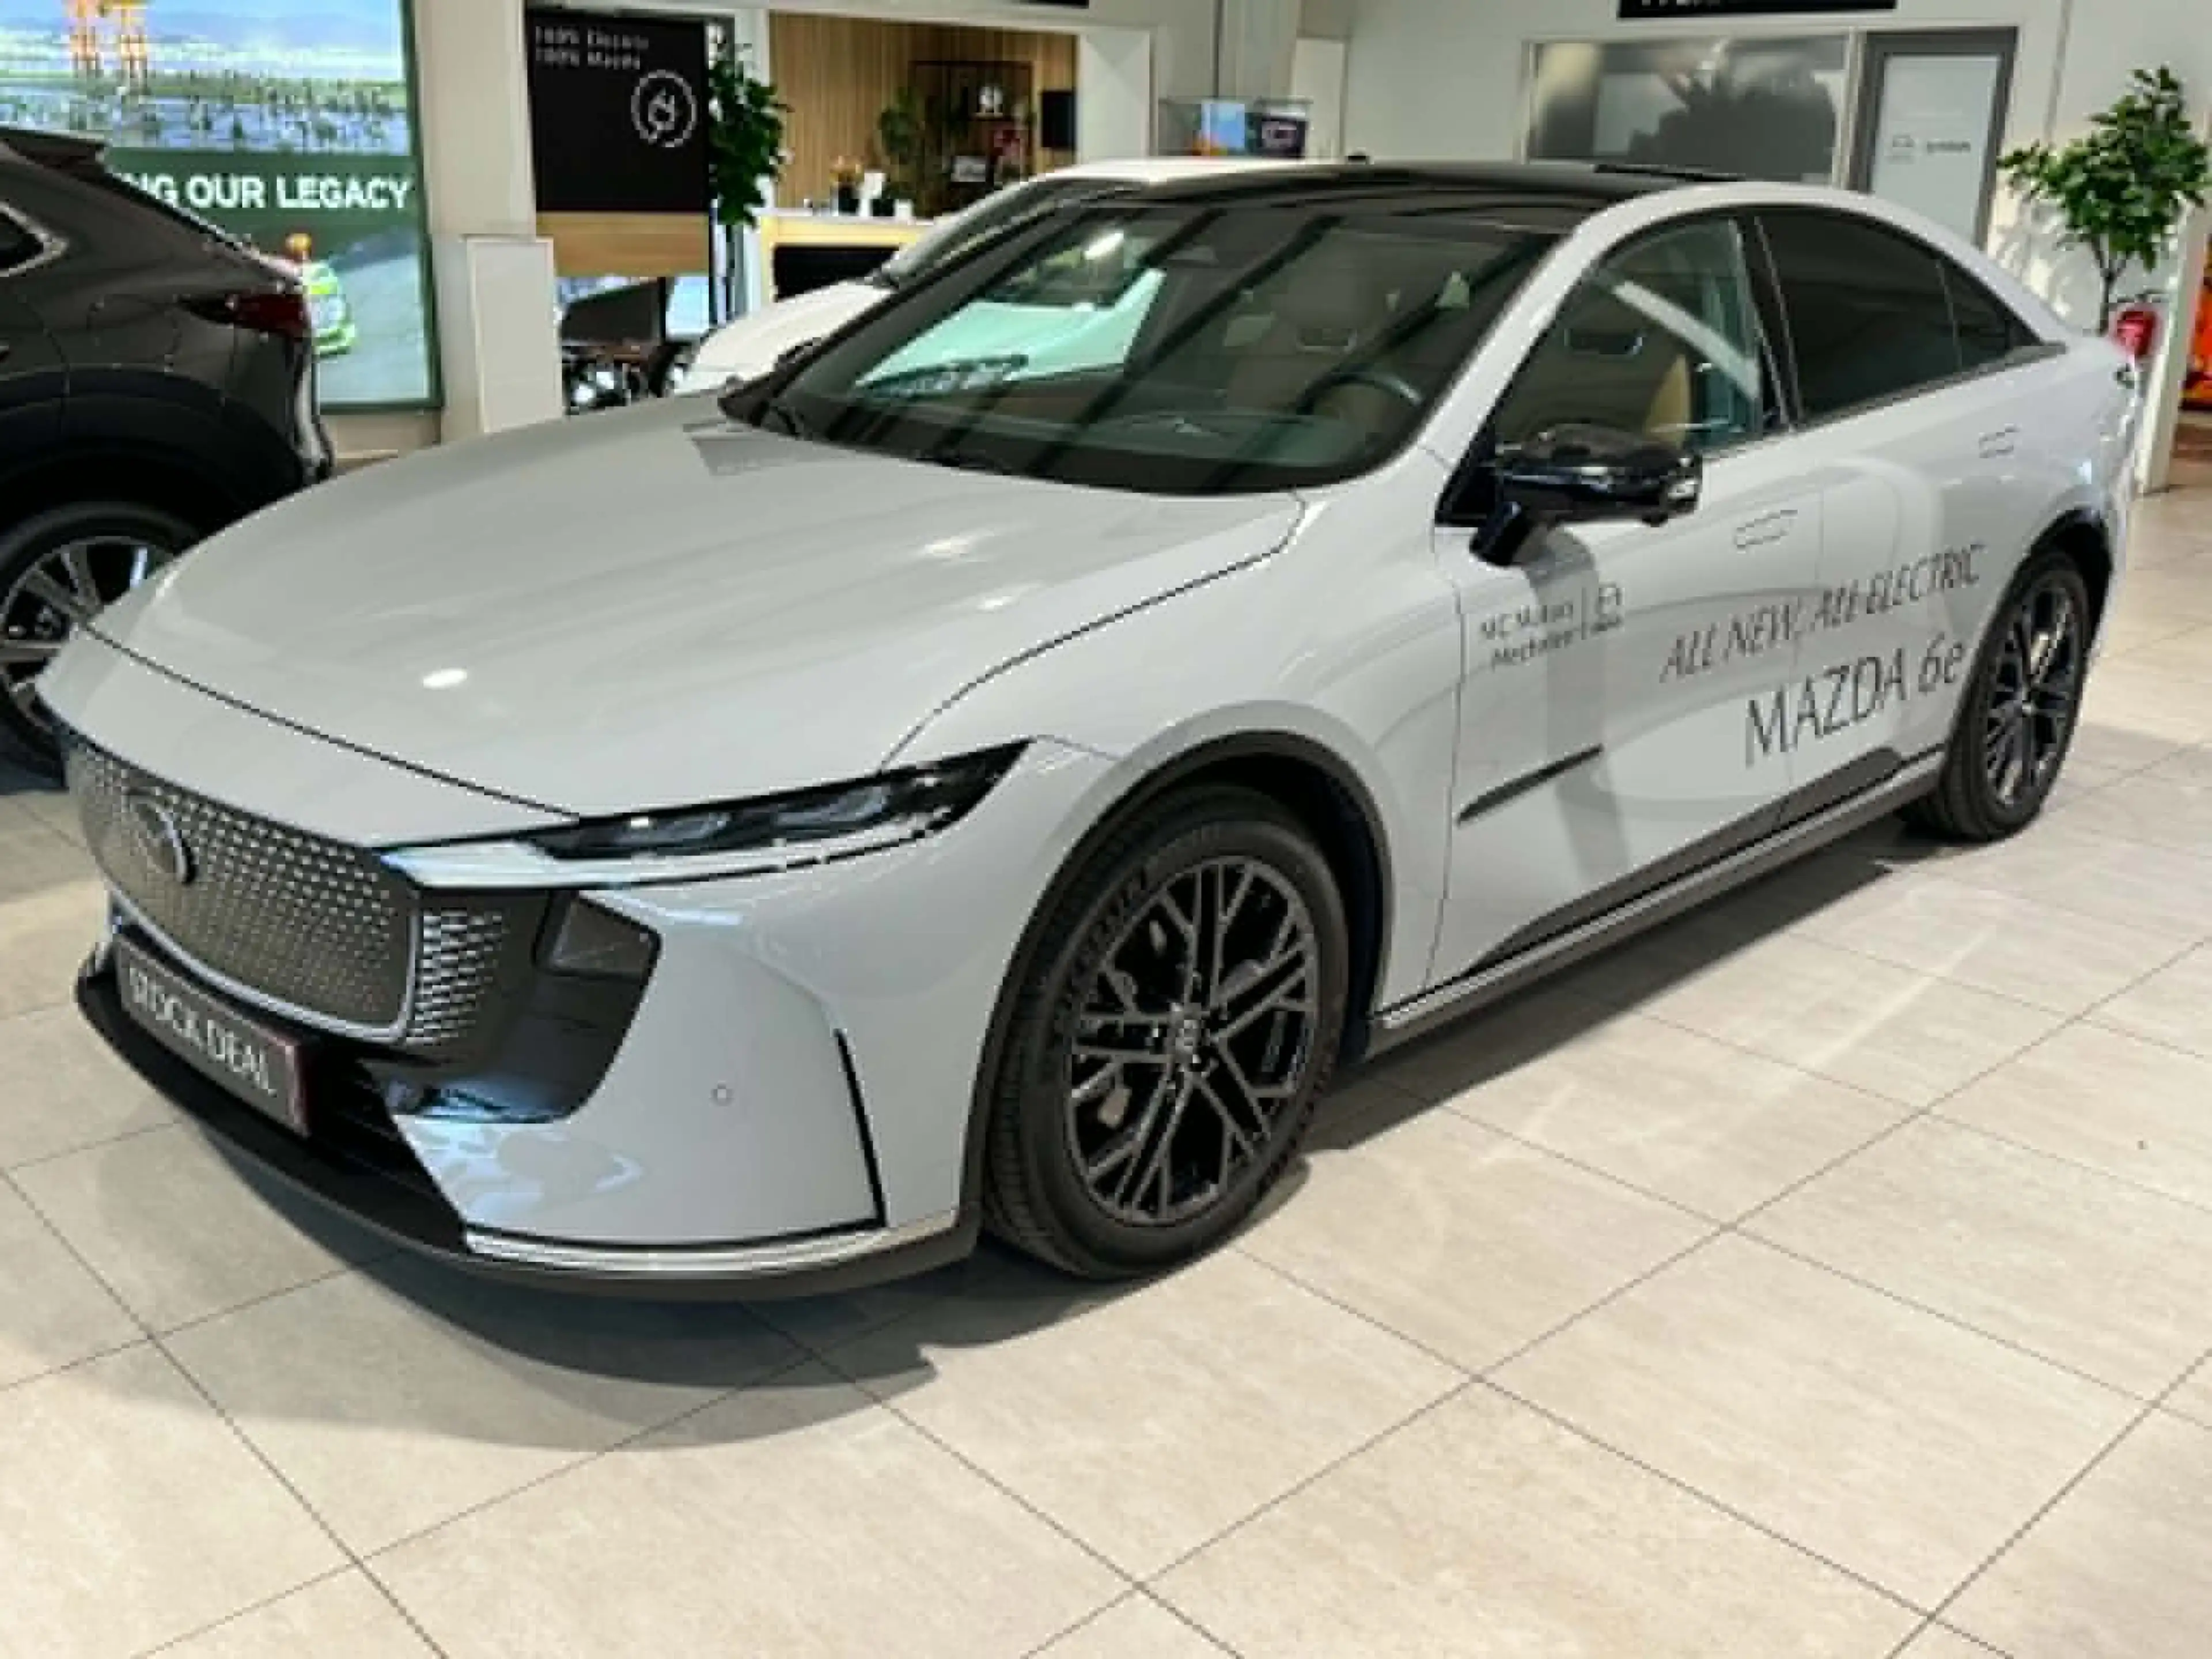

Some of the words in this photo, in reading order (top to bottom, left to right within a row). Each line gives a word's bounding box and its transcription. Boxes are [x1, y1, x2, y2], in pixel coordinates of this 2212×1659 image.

[185, 175, 266, 208] OUR
[276, 175, 411, 208] LEGACY
[1659, 622, 1718, 683] ALL
[1746, 648, 1911, 768] MAZDA
[1918, 632, 1963, 692] 6e
[130, 968, 205, 1053] STOCK
[207, 1018, 278, 1098] DEAL
